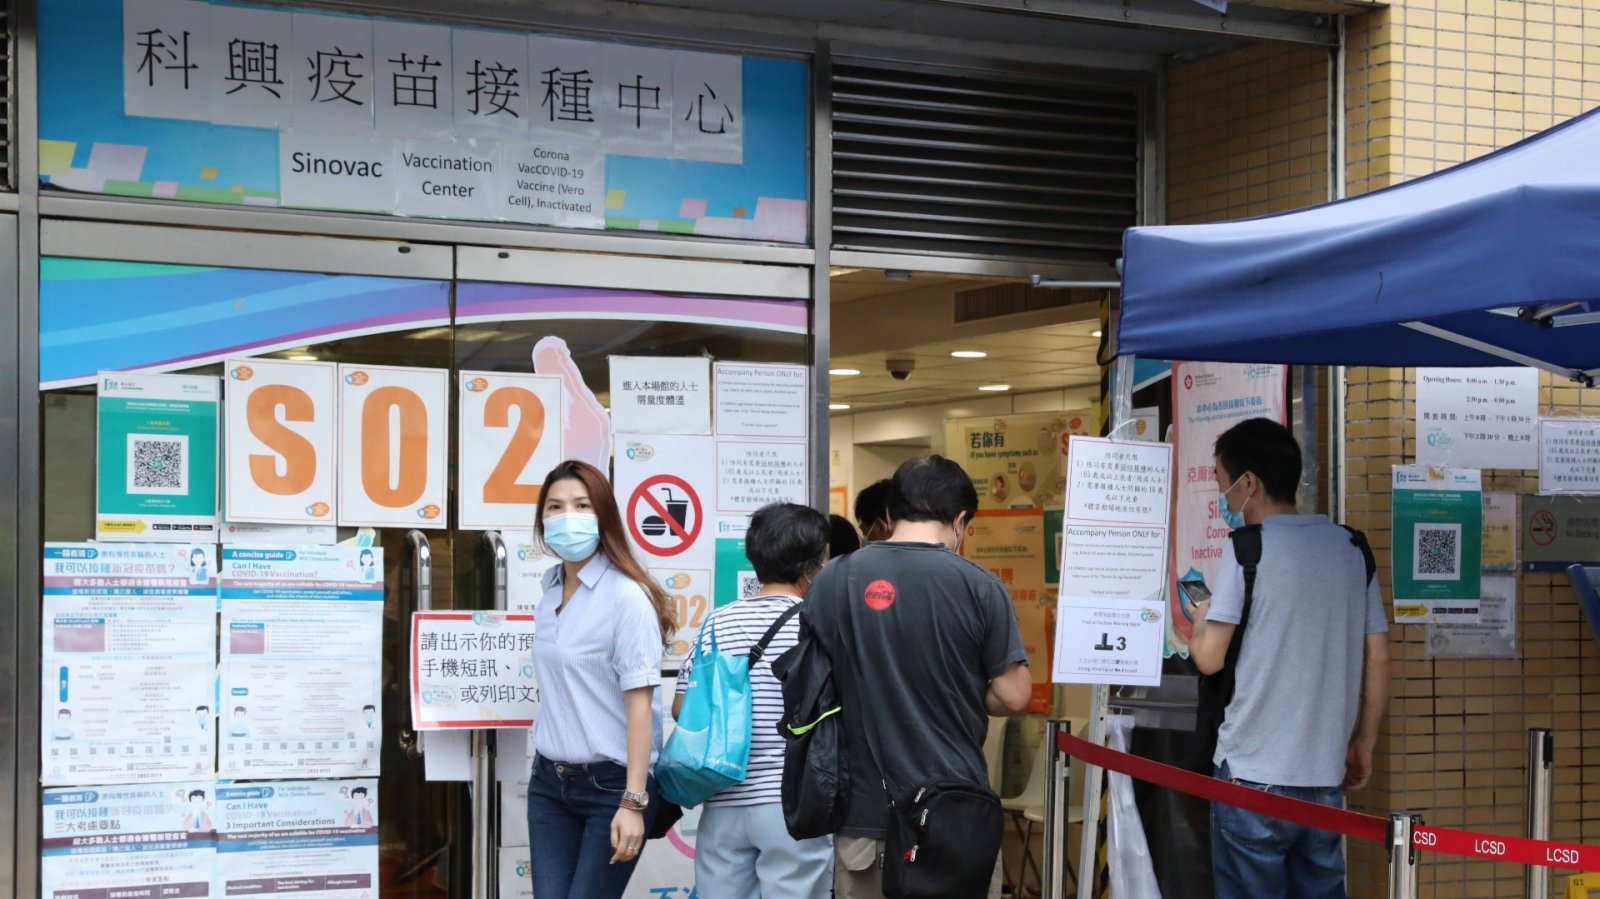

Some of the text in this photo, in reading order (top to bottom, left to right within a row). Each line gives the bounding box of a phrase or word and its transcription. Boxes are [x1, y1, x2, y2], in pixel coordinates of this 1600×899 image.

[135, 28, 735, 135] 科興疫苗接種中心
[533, 147, 570, 161] Corona
[292, 152, 382, 178] Sinovac
[402, 152, 493, 173] Vaccination
[518, 163, 584, 179] VacCOVID-19
[422, 181, 475, 197] Center
[516, 179, 585, 196] Vaccine (Vero
[537, 199, 592, 214] Inactivated
[622, 381, 698, 392] 進入本場館的人士
[970, 432, 1004, 449] 若你有
[1067, 528, 1107, 538] Accompany
[1108, 529, 1130, 538] Person
[1116, 637, 1127, 651] 3
[232, 820, 274, 830] Important
[275, 818, 336, 827] Considerations
[1412, 830, 1579, 864] CSD LCSD LCSD
